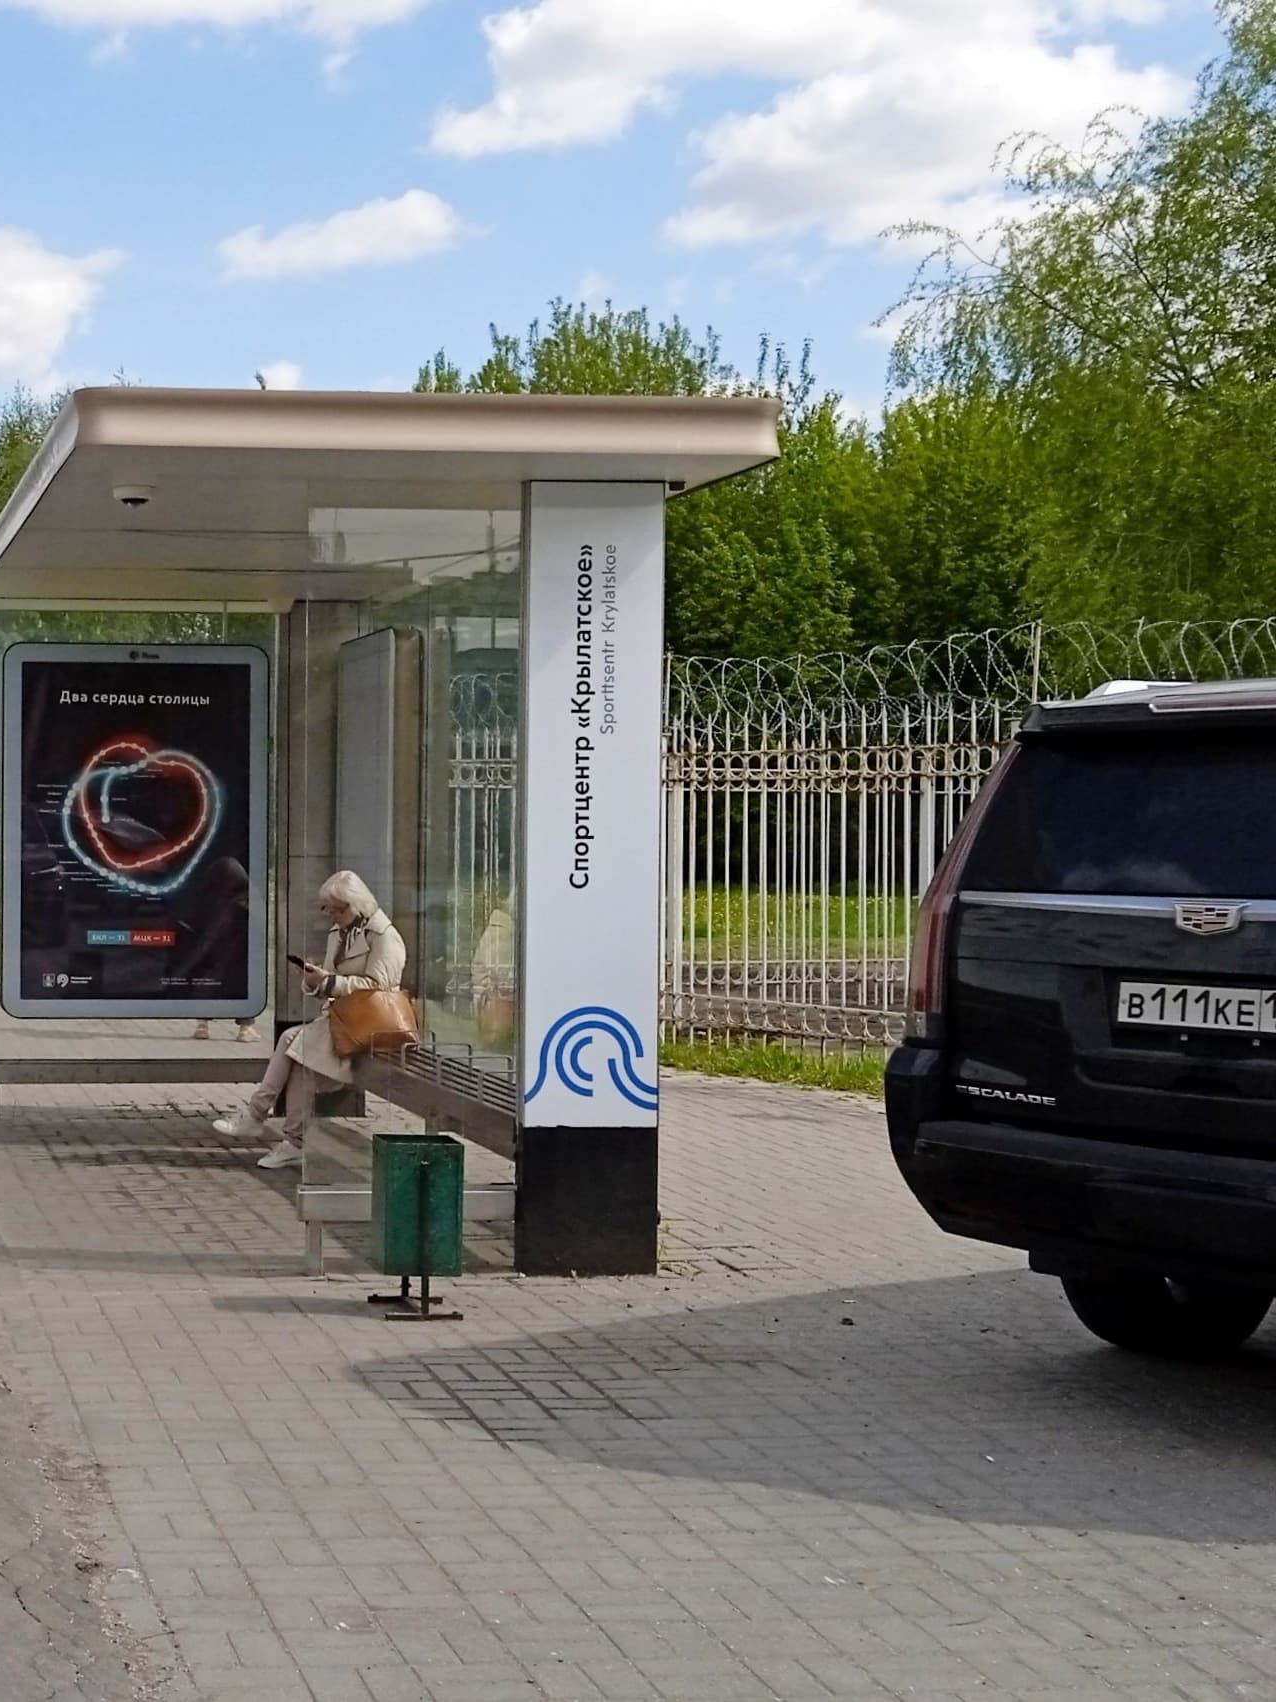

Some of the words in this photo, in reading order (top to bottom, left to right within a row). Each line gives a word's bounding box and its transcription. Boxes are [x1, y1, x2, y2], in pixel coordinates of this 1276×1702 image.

[601, 544, 619, 633] Krylatskoe
[571, 544, 595, 728] «Крылатское»
[59, 690, 88, 704] Два
[92, 693, 145, 706] сердца
[149, 694, 210, 706] столицы
[599, 640, 617, 734] Sporttsentr
[569, 736, 595, 889] Спортцентр
